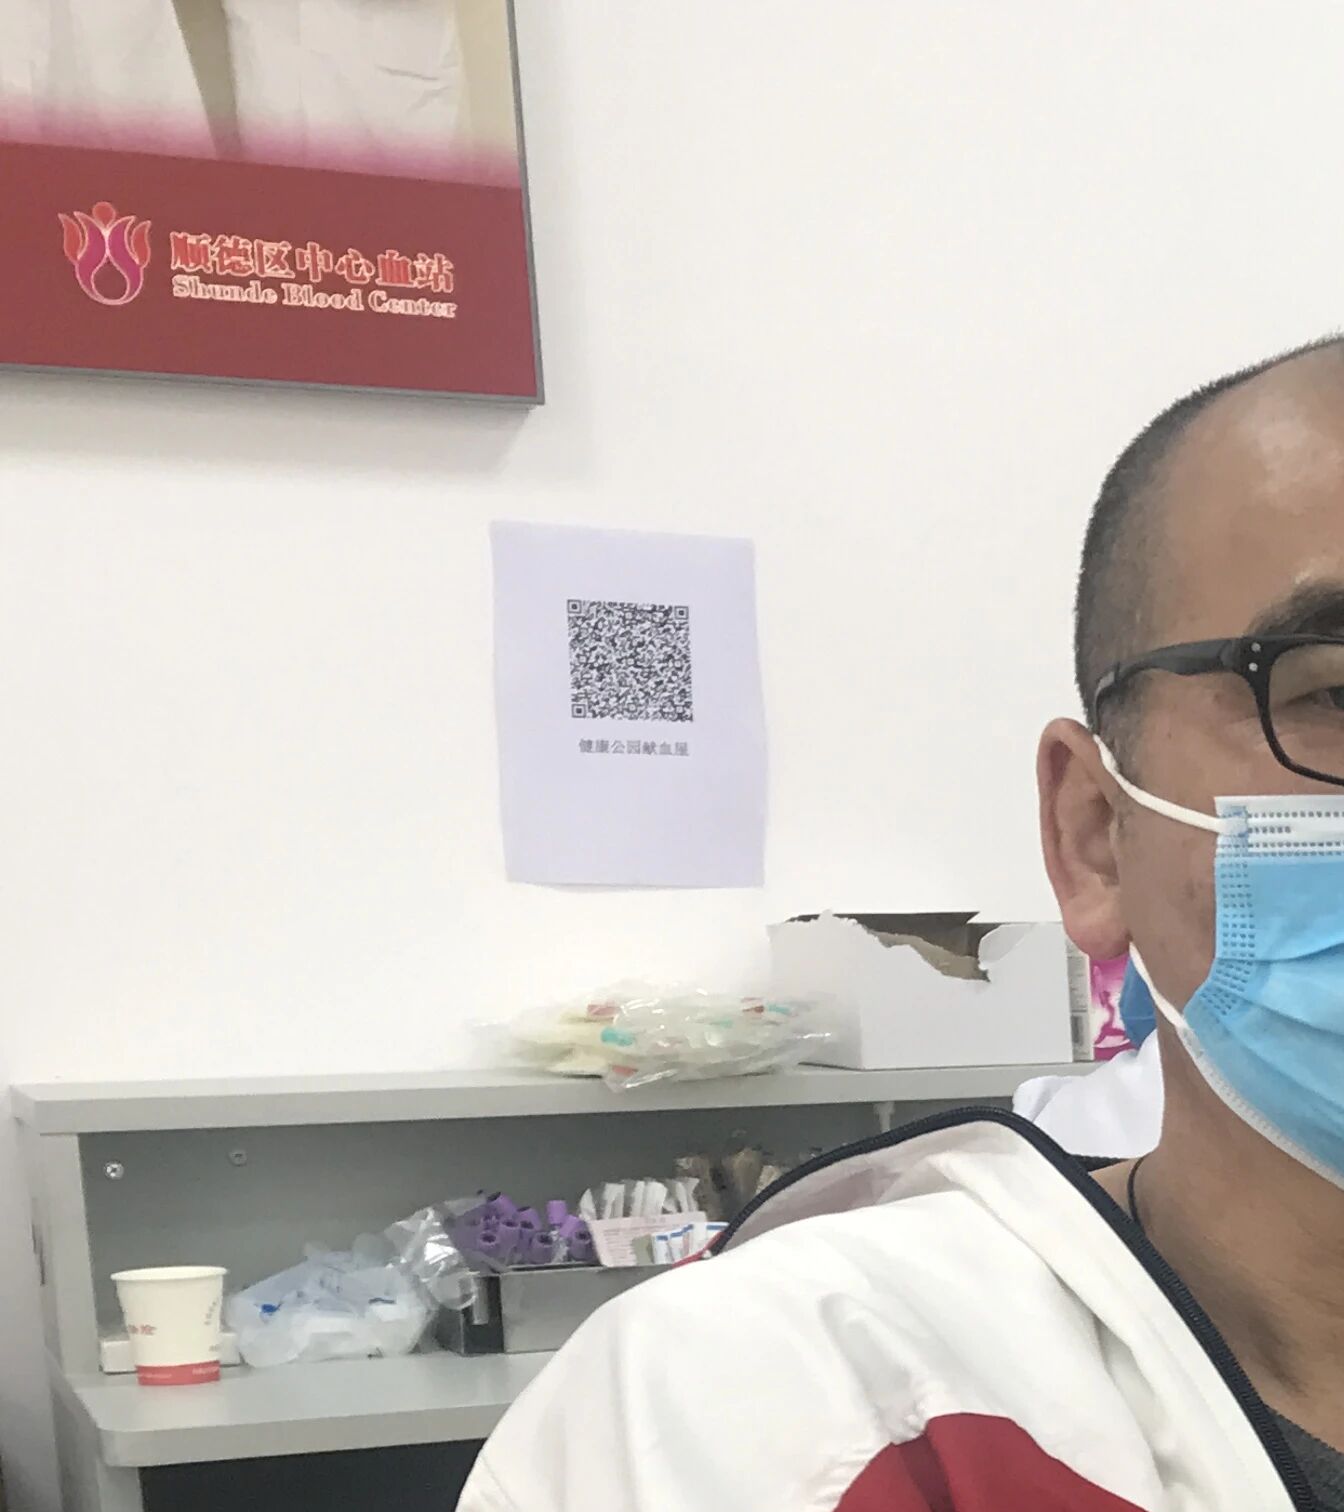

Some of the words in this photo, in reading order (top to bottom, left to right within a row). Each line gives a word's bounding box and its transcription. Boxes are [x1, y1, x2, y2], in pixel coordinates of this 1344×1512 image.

[169, 232, 454, 293] 顺德区中心血站
[171, 274, 278, 304] Shunde
[281, 282, 365, 311] Blood
[368, 290, 457, 318] Center
